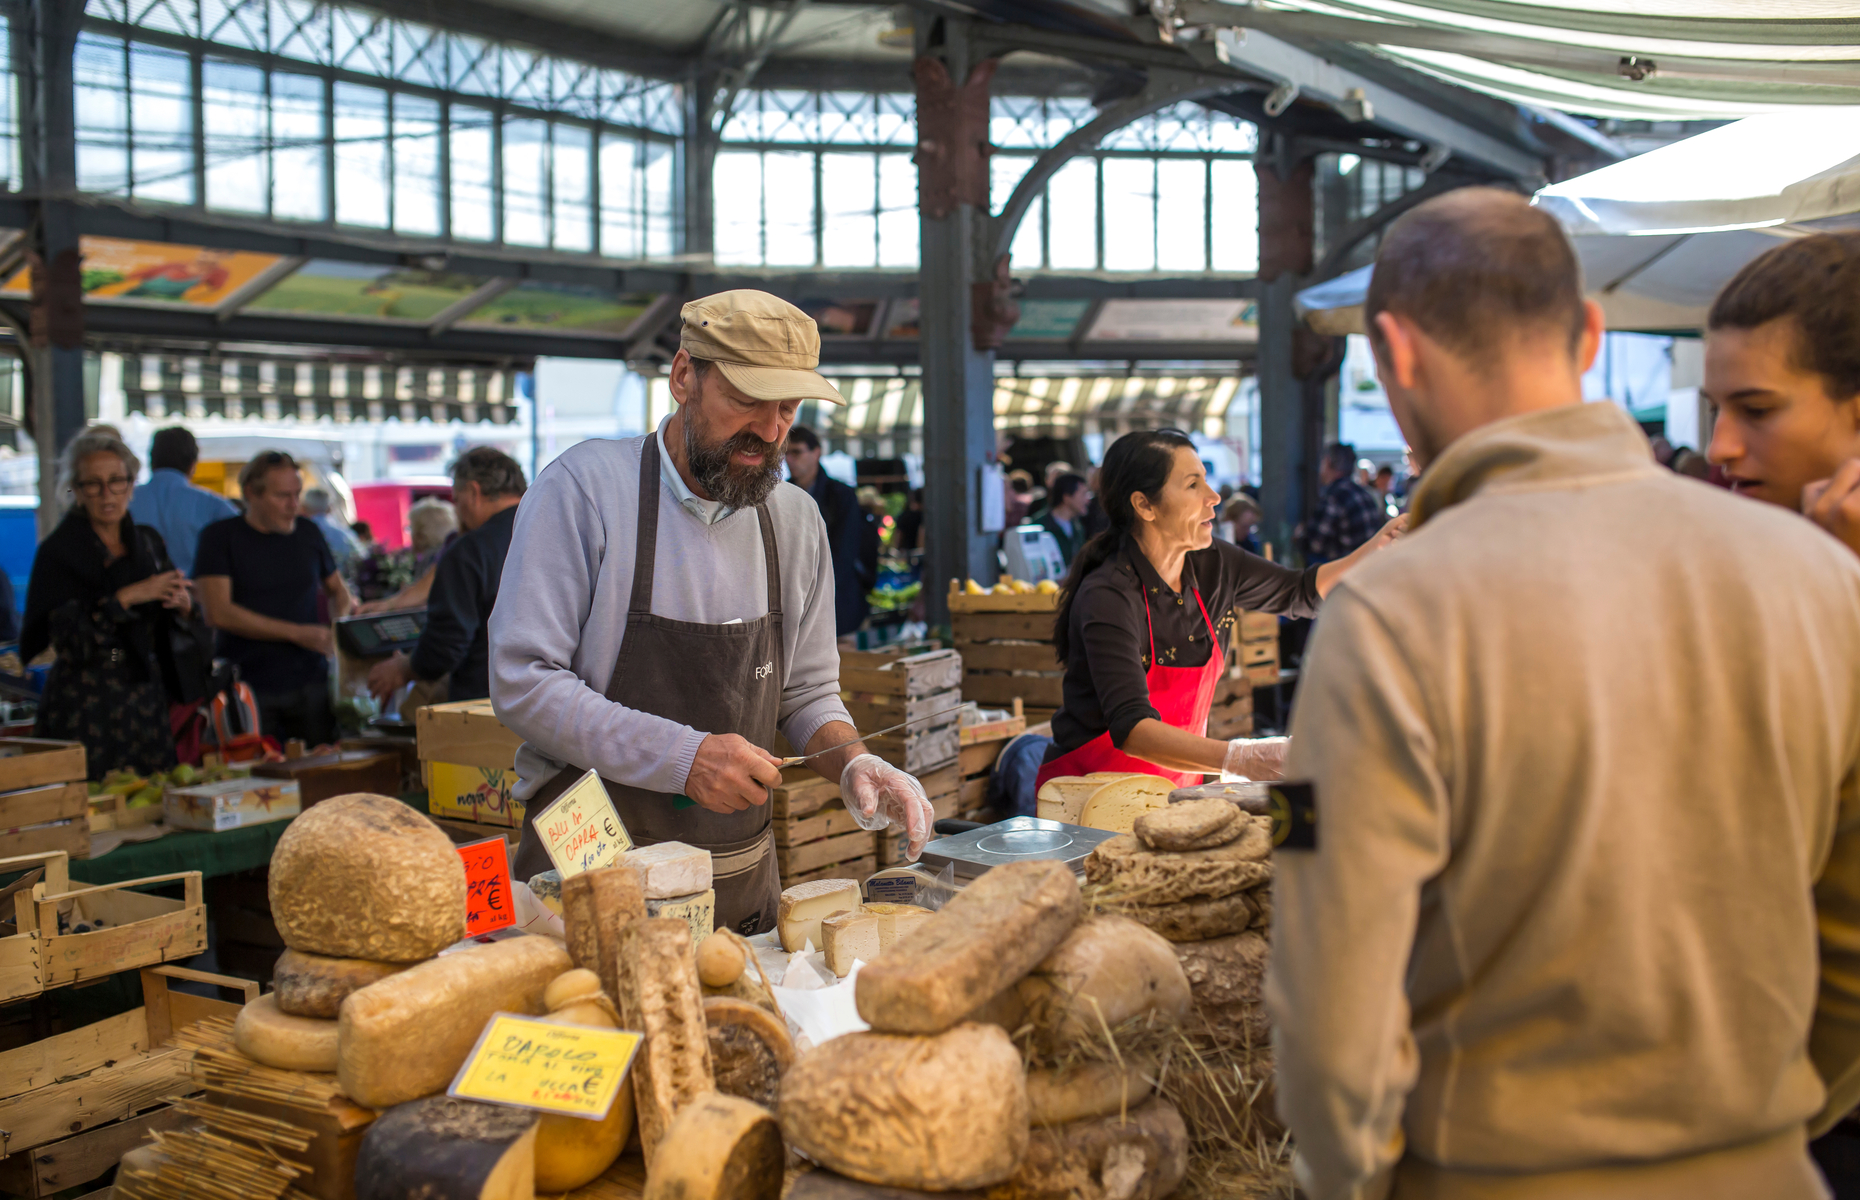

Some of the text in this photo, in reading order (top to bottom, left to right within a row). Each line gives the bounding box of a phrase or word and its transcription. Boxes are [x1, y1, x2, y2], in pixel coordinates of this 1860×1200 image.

[547, 820, 570, 847] BLU
[603, 816, 617, 838] €
[564, 823, 600, 862] CAPRA
[487, 888, 503, 911] €
